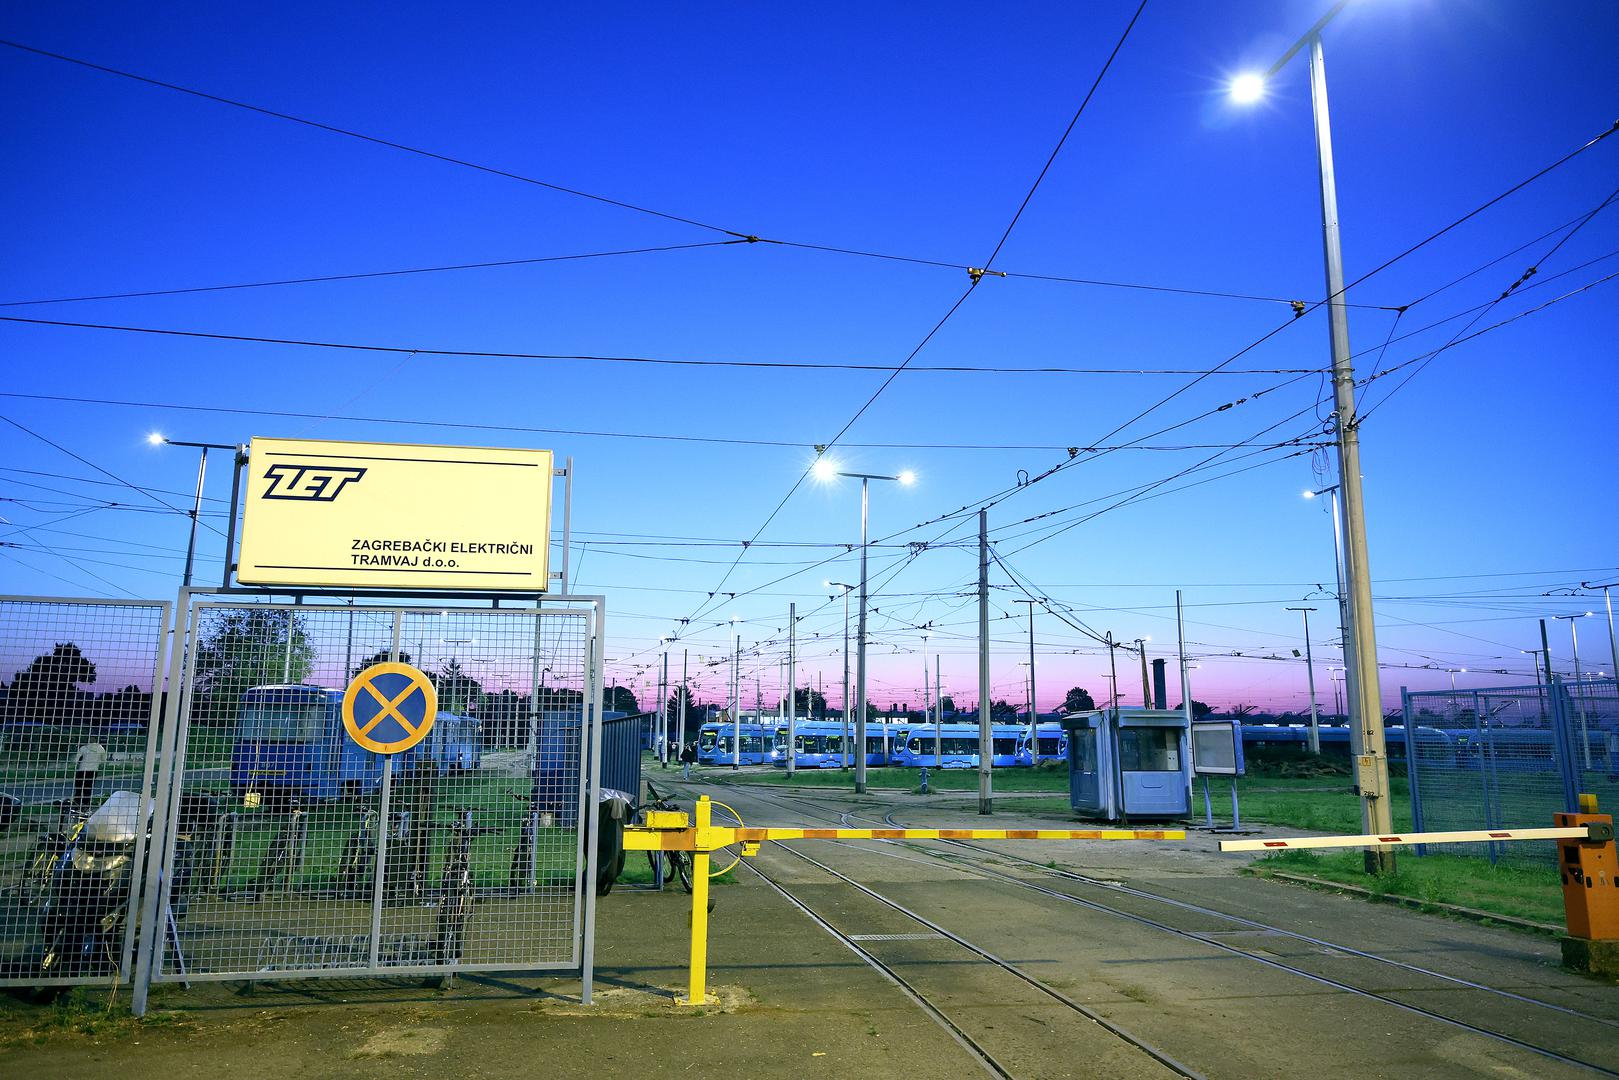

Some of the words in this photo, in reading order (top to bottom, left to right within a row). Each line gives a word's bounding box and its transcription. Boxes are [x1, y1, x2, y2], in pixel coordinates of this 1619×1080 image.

[261, 463, 368, 502] ZET
[351, 538, 447, 553] ZAGREBAČKI
[450, 541, 533, 555] ELEKTRIČNI
[351, 554, 418, 567] TRAMVAJ
[422, 556, 460, 568] d.o.o.
